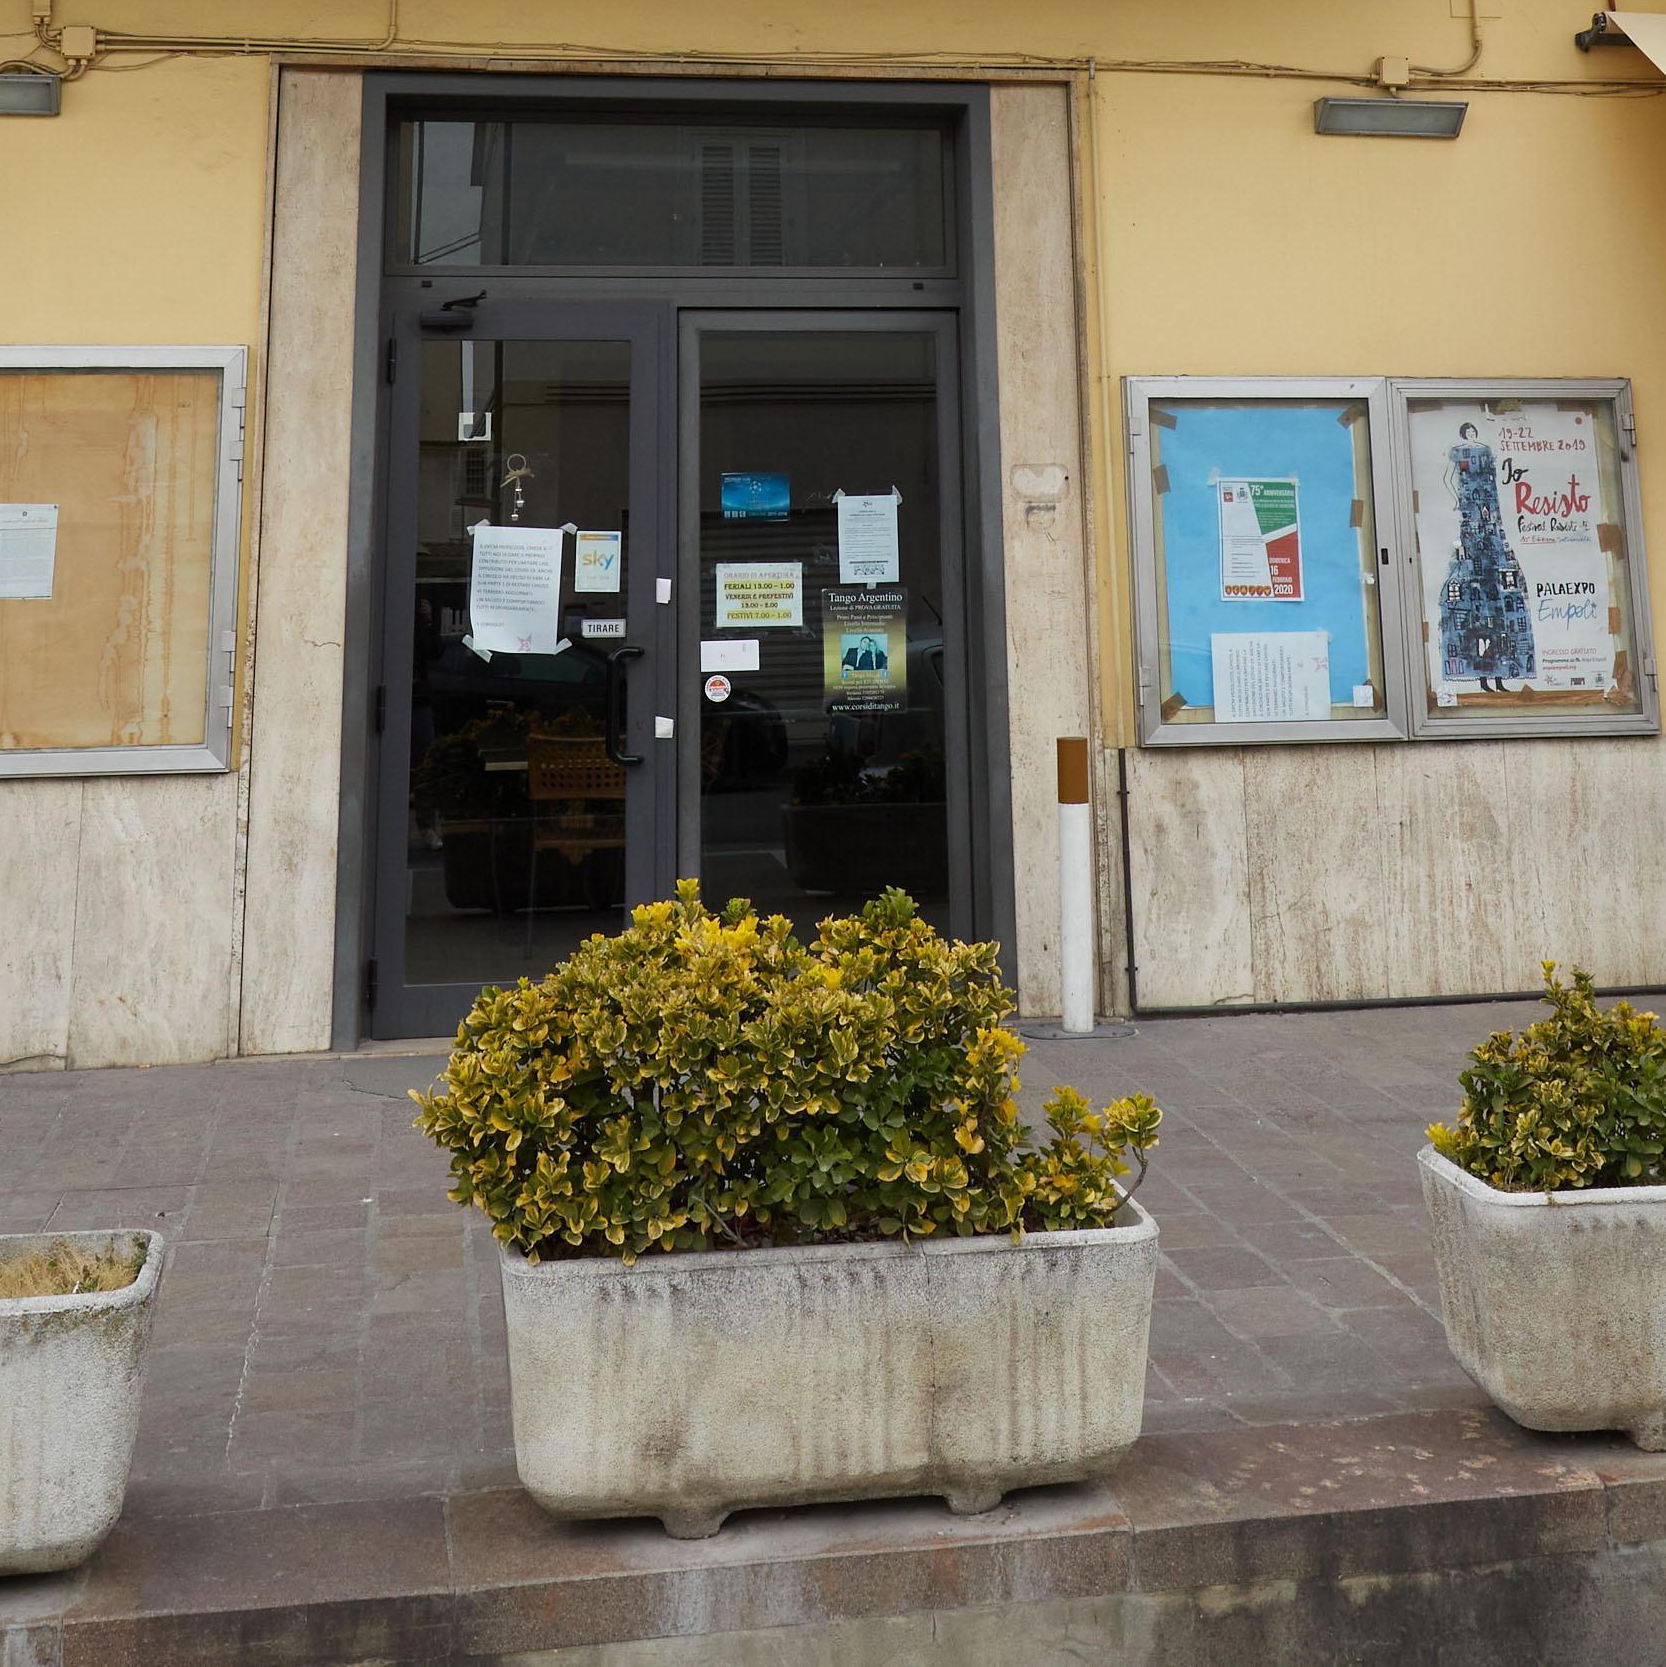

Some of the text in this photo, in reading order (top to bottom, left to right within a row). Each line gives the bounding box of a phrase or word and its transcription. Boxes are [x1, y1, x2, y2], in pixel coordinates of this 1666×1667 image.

[1498, 427, 1534, 440] 19-22
[1500, 438, 1586, 452] SETTEMBRE 2019
[1515, 473, 1592, 519] Resisto
[1517, 515, 1546, 533] Festival
[582, 549, 615, 571] sky
[1270, 565, 1279, 576] 16
[1274, 584, 1293, 595] 2020
[1536, 582, 1596, 598] PALAEXPO
[828, 591, 903, 605] Tango Argentino
[727, 612, 753, 620] FESTIVI
[777, 611, 792, 619] 1.00
[1538, 598, 1597, 631] Empoli
[587, 624, 620, 633] TIRARE
[832, 701, 900, 711] www.corsiditango.it
